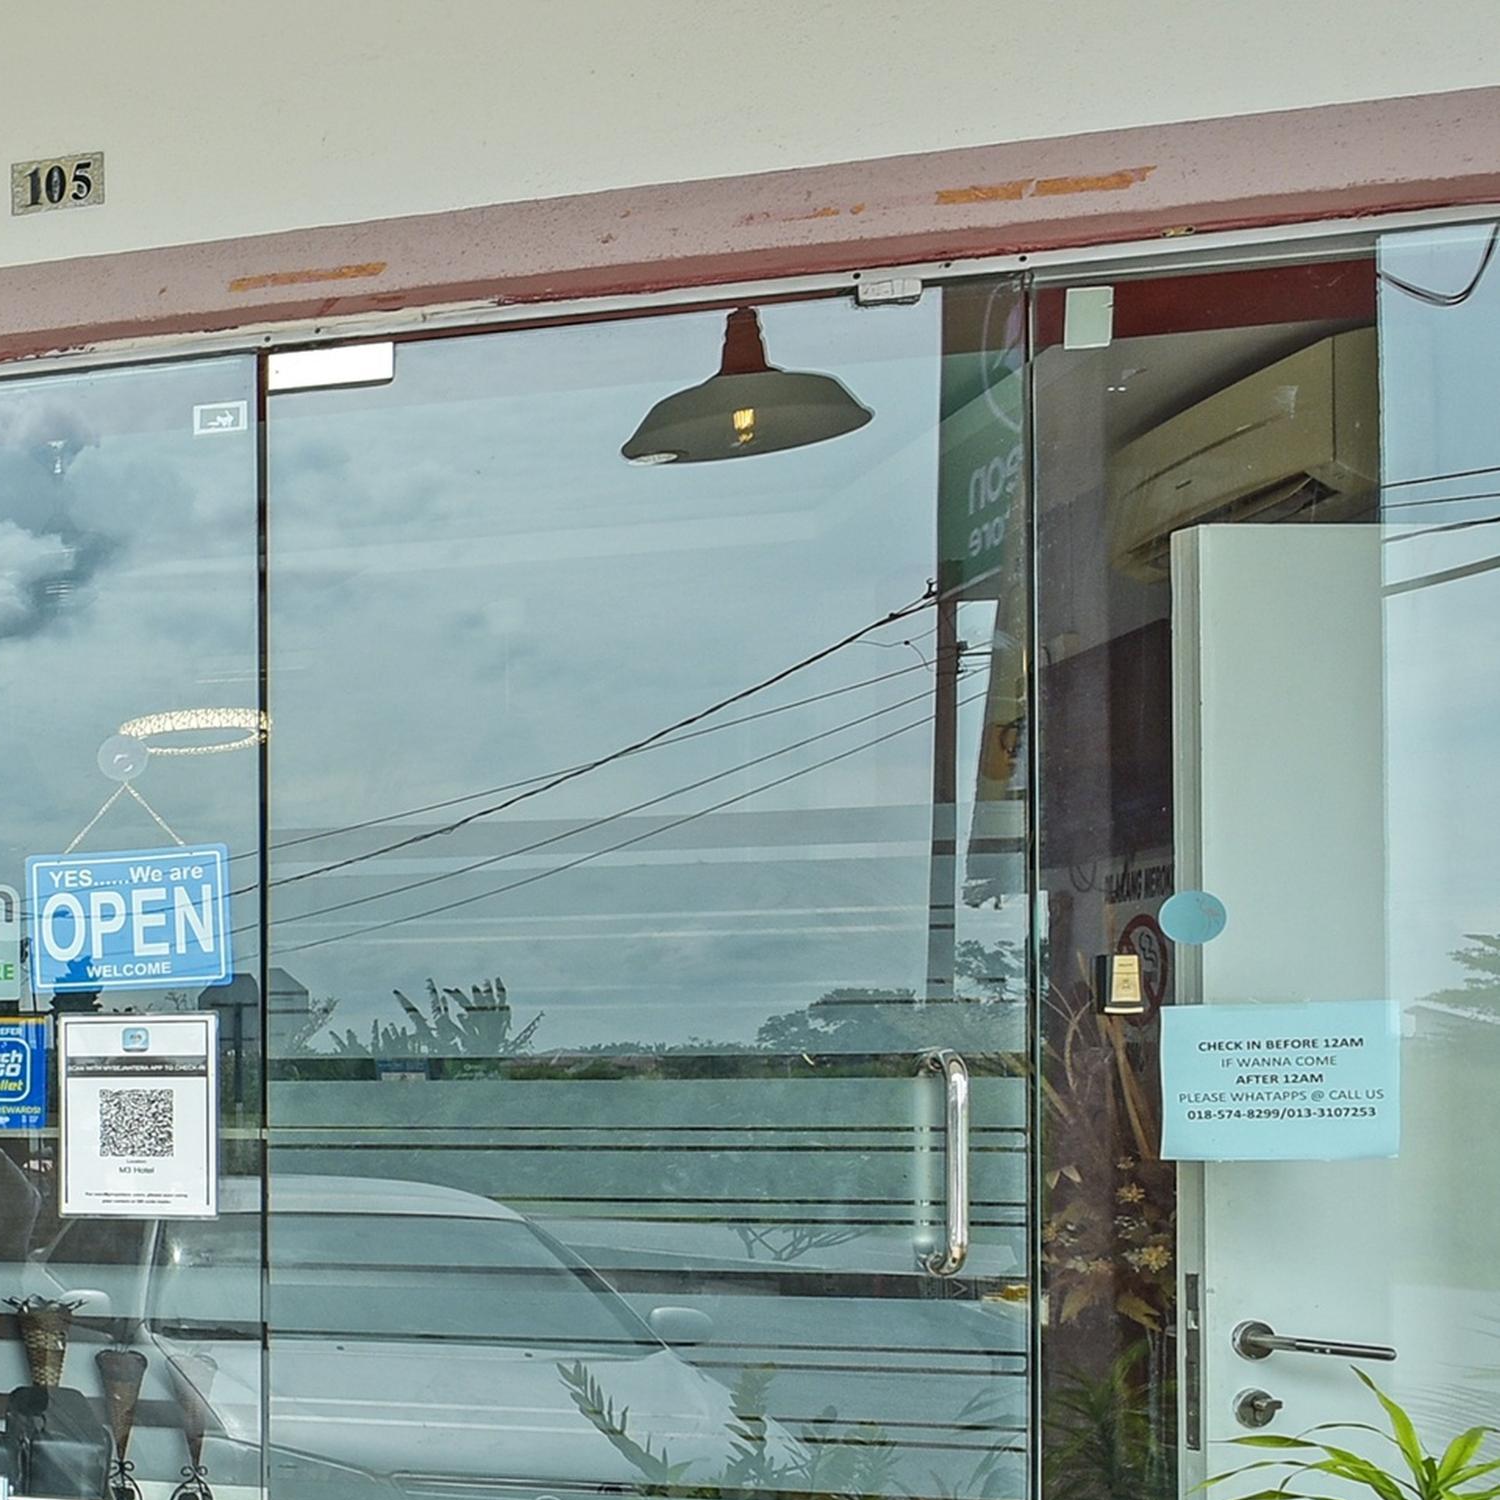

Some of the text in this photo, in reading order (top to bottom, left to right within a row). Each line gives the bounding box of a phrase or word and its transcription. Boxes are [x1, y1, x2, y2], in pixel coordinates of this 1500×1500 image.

[23, 161, 92, 207] 105
[169, 865, 203, 881] are
[42, 884, 214, 962] OPEN
[86, 961, 172, 978] WELCOME
[1198, 1037, 1364, 1052] CHECK IN BEFORE 12AM
[1221, 1055, 1337, 1068] IF WANNA COME
[1235, 1073, 1324, 1085] AFTER 12AM
[1179, 1089, 1385, 1104] PLEASE WHATAPPS @ CALL US
[1187, 1106, 1377, 1120] 018-574-8299/013-3107253
[133, 1166, 155, 1174] Hotel
